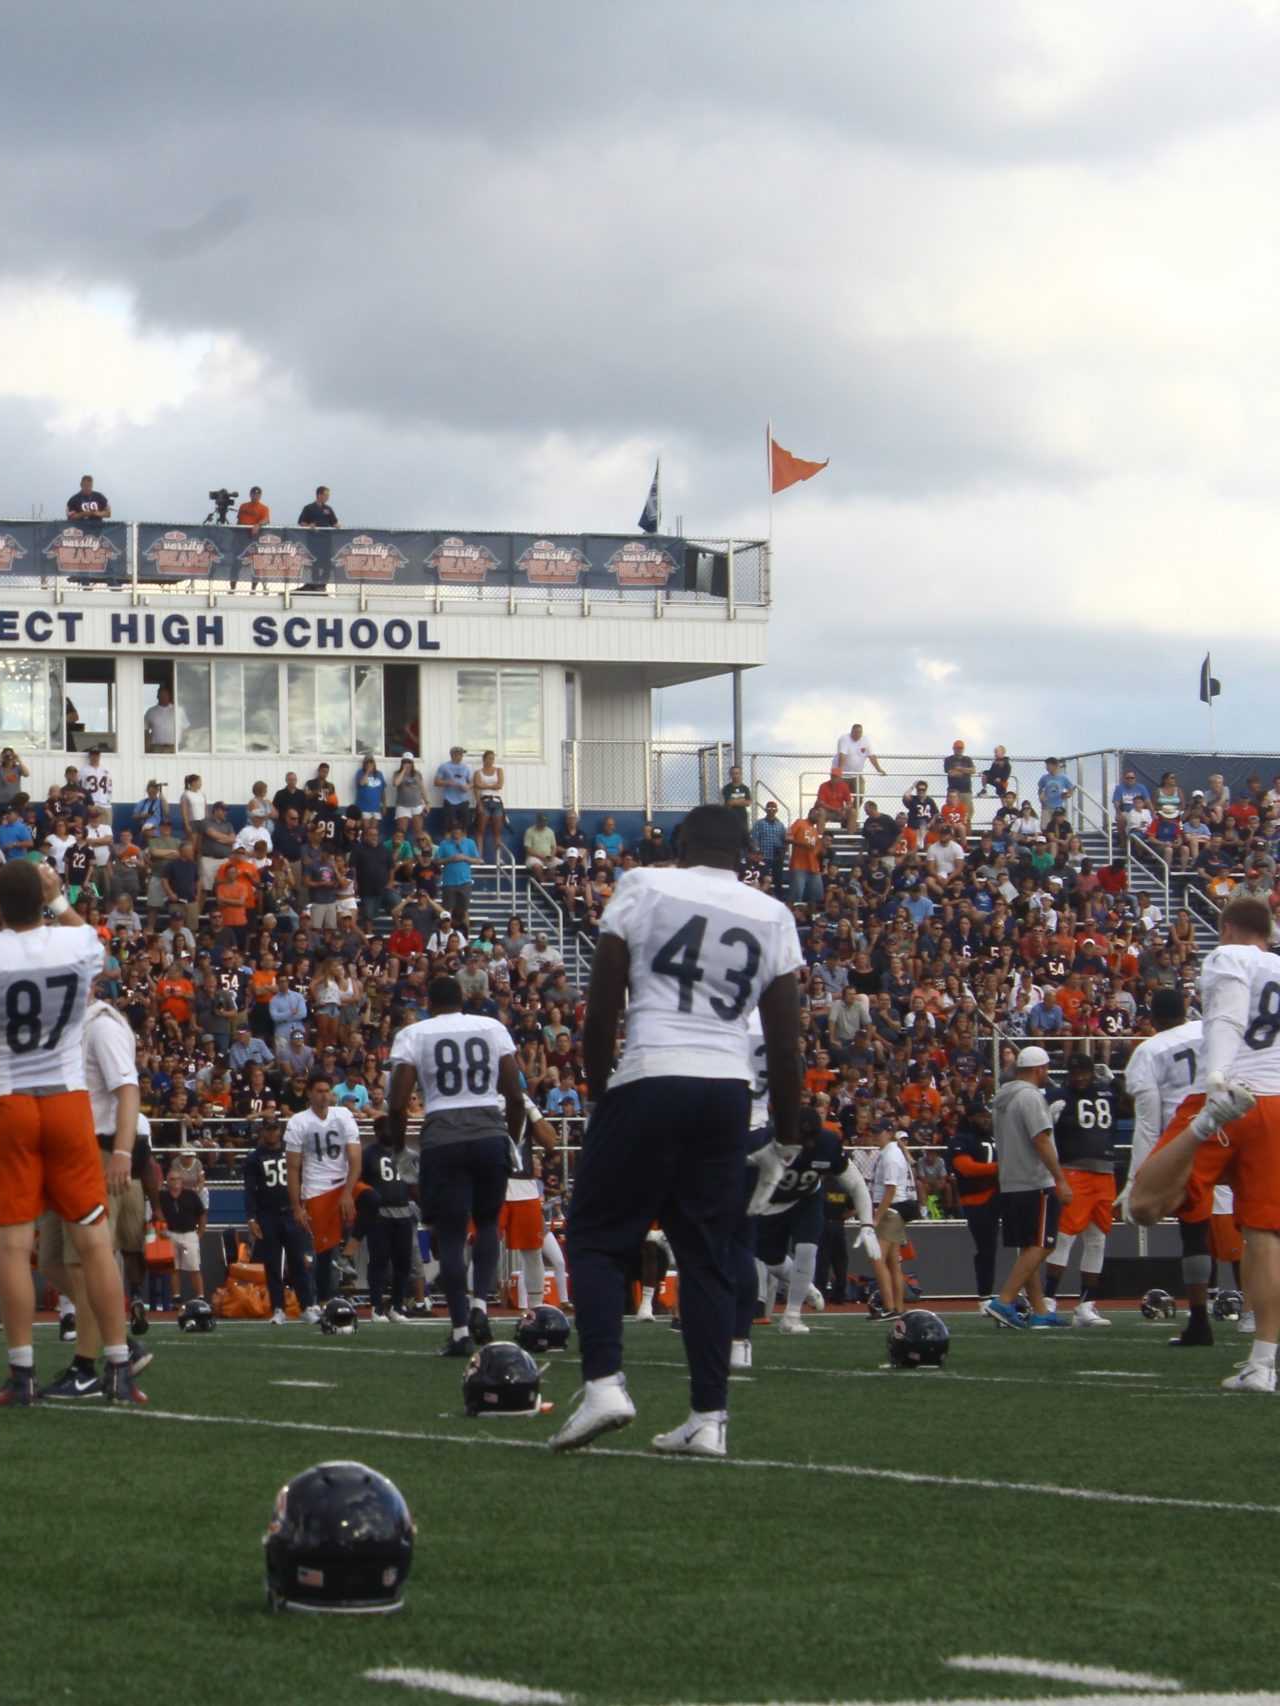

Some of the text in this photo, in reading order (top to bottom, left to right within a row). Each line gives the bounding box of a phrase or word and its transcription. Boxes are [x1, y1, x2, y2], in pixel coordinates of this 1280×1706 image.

[111, 613, 224, 646] HIGH
[253, 616, 441, 651] SCHOOL
[87, 776, 109, 794] 34
[917, 804, 931, 817] 34
[73, 853, 86, 869] 22
[651, 915, 762, 1021] 43
[1049, 961, 1064, 976] 54
[221, 974, 239, 991] 54
[5, 971, 79, 1054] 87
[434, 1036, 491, 1097] 88
[1078, 1099, 1112, 1130] 68
[314, 1130, 341, 1162] 16
[380, 1157, 402, 1182] 6
